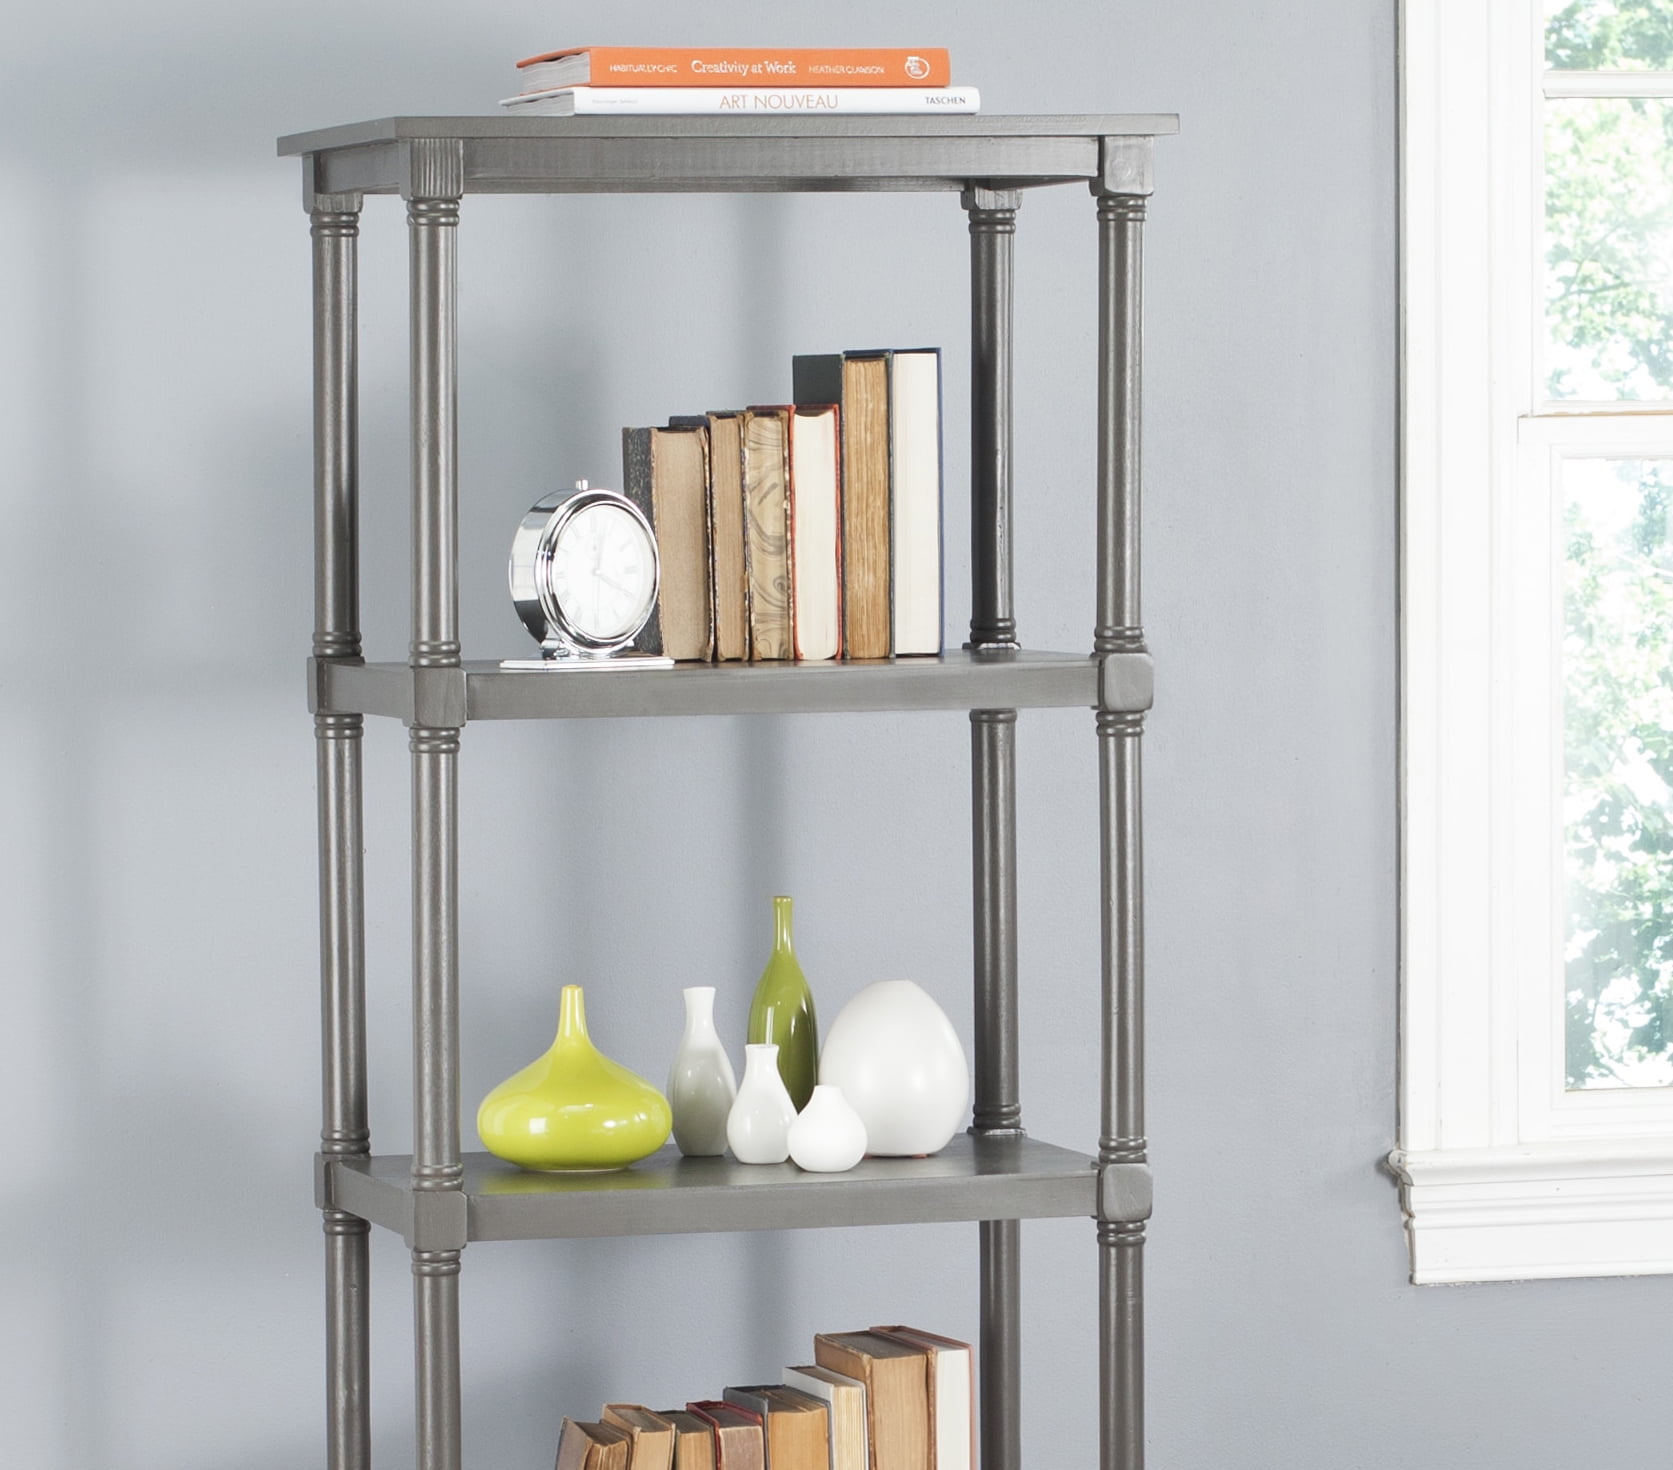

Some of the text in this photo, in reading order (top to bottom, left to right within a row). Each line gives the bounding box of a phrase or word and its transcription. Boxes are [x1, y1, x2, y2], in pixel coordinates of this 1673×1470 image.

[691, 60, 797, 77] Creativity at Work
[809, 64, 845, 74] HEATHER
[719, 94, 839, 110] ART NOUVEAU
[925, 96, 966, 105] TASCHEN
